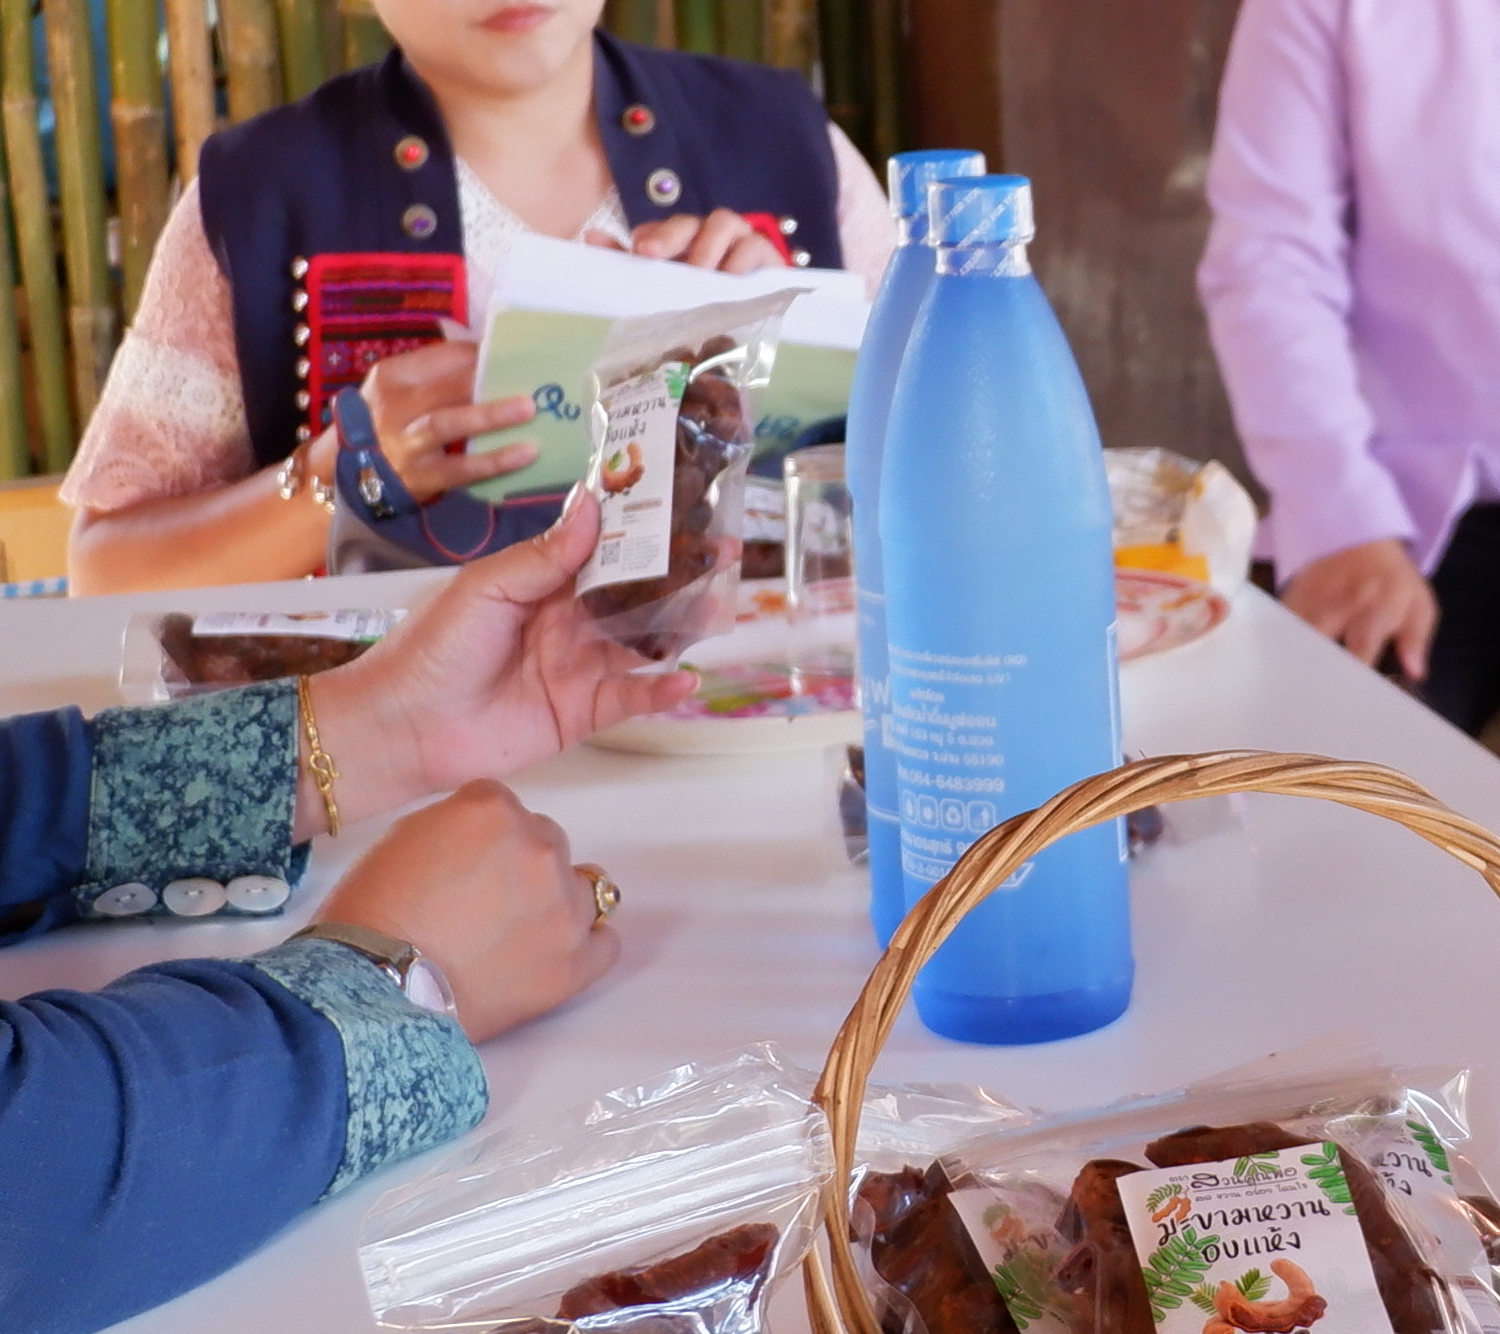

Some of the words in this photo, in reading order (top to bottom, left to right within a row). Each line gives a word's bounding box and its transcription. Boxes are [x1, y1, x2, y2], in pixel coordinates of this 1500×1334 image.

[1157, 1199, 1331, 1247] มะขามหวาน
[1201, 1226, 1301, 1263] อบแห้ง
